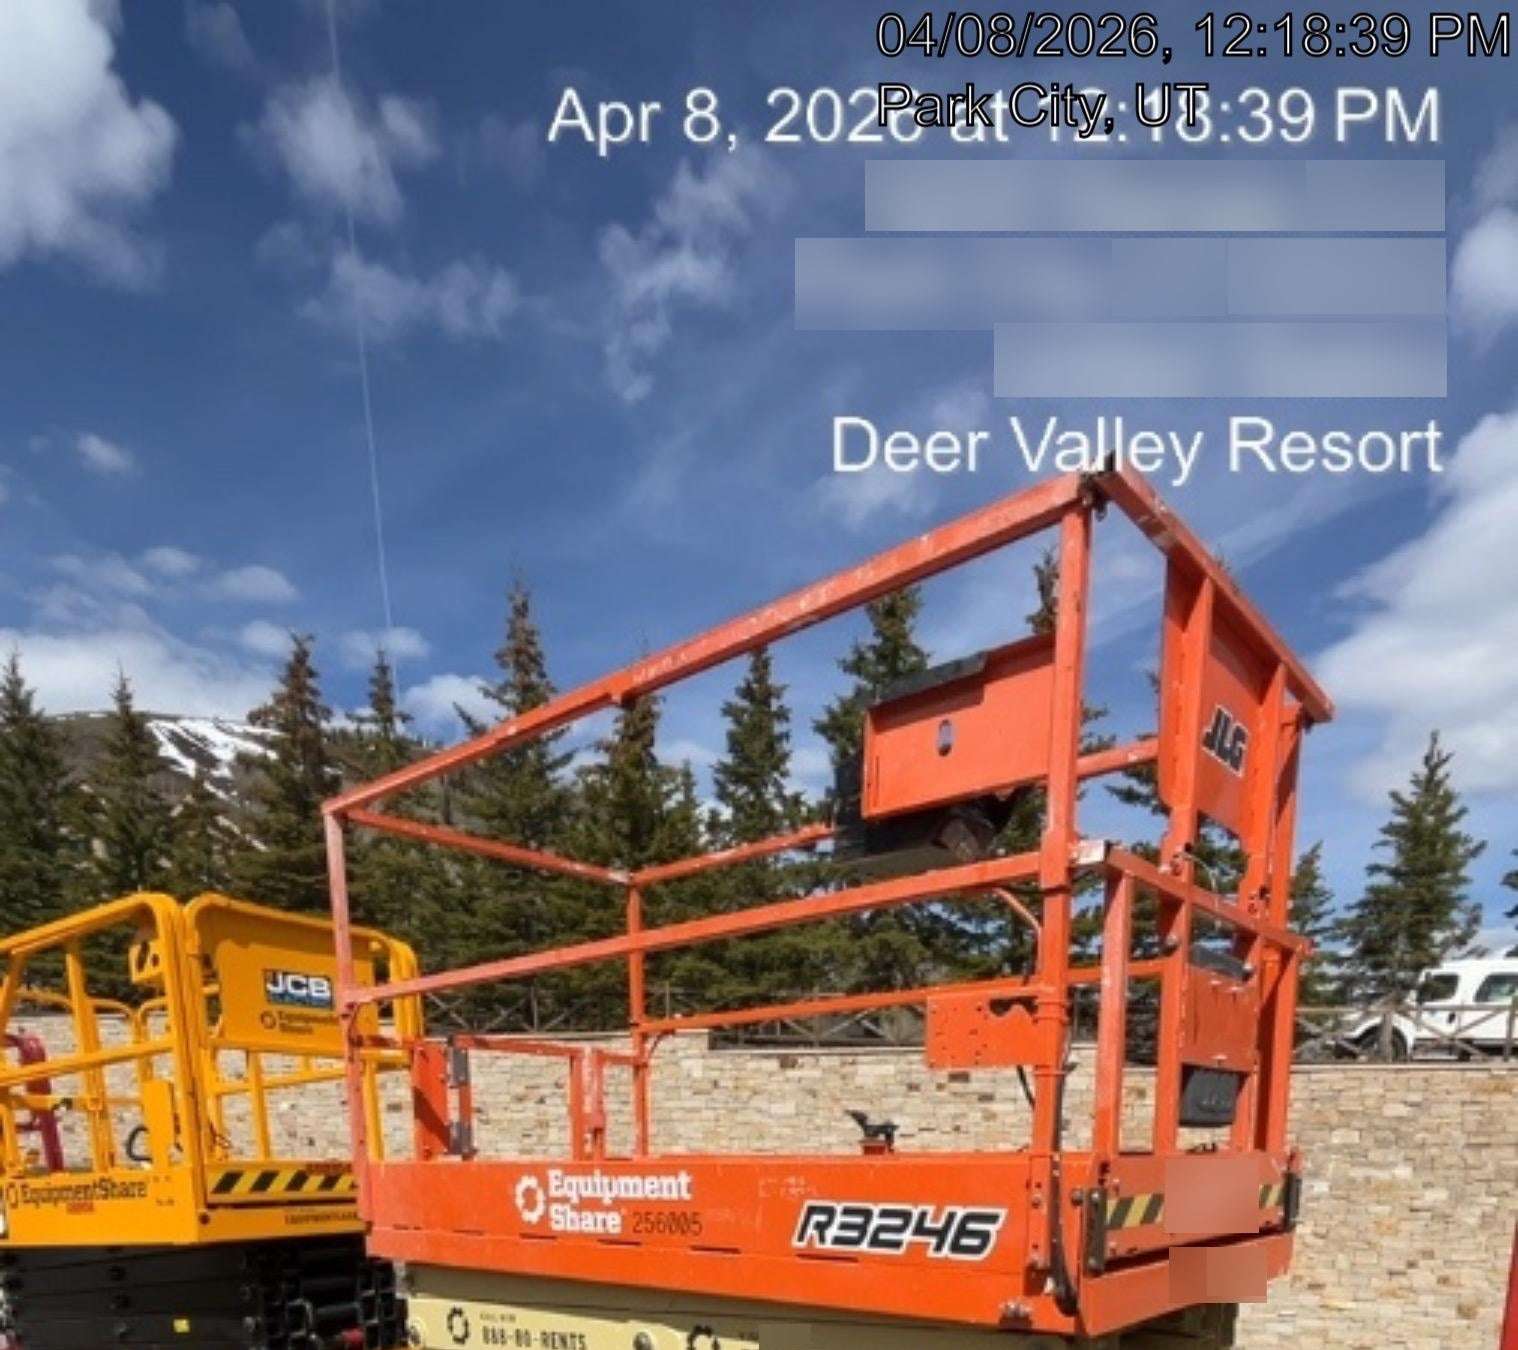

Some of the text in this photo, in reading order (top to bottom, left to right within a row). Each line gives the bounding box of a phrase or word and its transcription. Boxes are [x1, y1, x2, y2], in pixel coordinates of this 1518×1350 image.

[1202, 704, 1249, 777] JLG
[266, 971, 332, 998] JCB
[20, 1177, 147, 1208] EquipmentShare
[548, 1169, 691, 1205] Equipment
[549, 1202, 622, 1234] Share
[632, 1210, 703, 1237] 256005
[793, 1201, 1006, 1260] R3246
